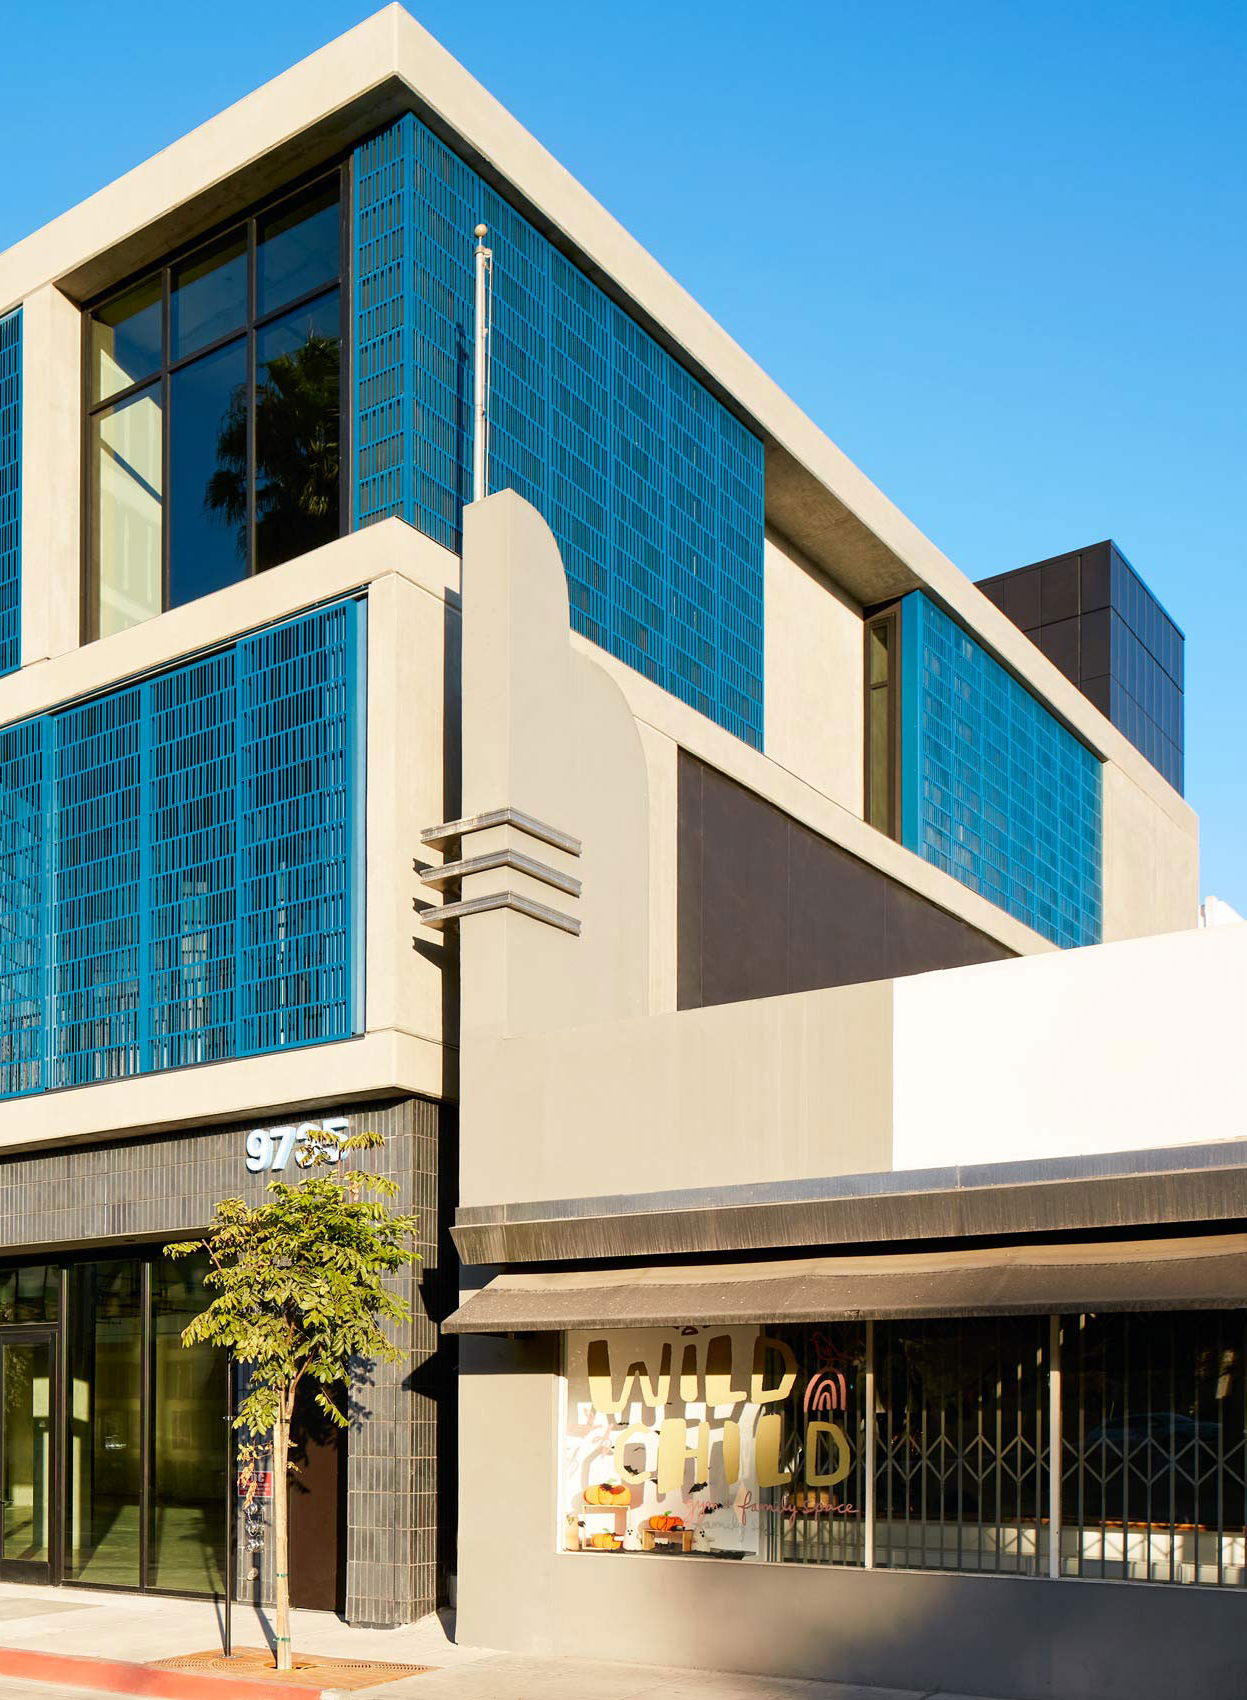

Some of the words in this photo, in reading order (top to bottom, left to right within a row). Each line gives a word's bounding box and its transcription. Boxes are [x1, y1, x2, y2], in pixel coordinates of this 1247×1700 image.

[587, 1334, 797, 1414] WILD
[613, 1414, 850, 1494] CHILD
[738, 1490, 797, 1528] family
[803, 1501, 860, 1520] space
